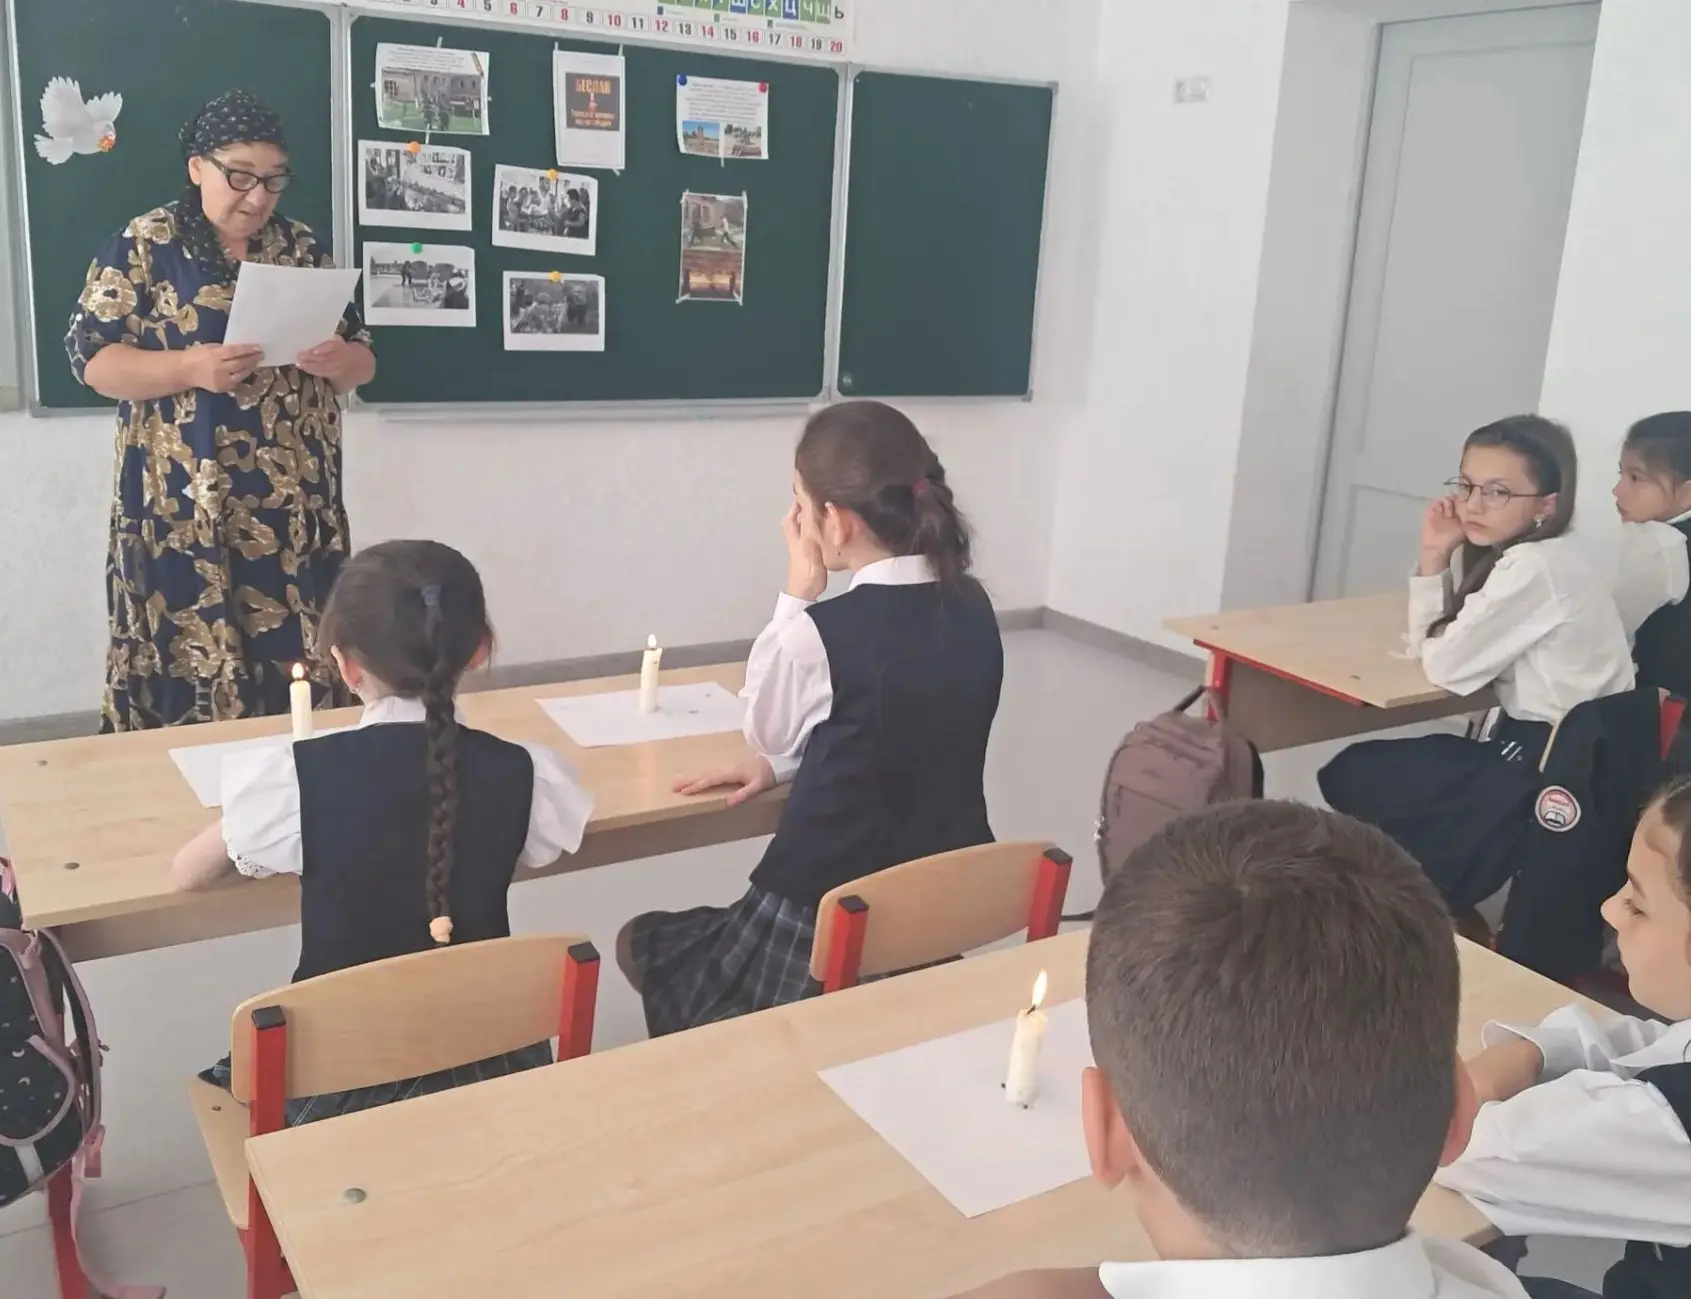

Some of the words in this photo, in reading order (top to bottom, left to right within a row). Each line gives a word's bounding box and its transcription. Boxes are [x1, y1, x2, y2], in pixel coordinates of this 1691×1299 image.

[484, 0, 491, 11] 5
[510, 2, 518, 15] 6
[535, 5, 543, 17] 7
[561, 8, 569, 20] 8
[586, 11, 594, 24] 9
[608, 14, 621, 27] 10
[631, 16, 645, 29] 11
[655, 20, 669, 33] 12
[679, 23, 692, 36] 13
[702, 25, 714, 38] 14
[724, 28, 737, 41] 15
[747, 31, 759, 43] 16
[769, 33, 781, 46] 17
[790, 36, 803, 48] 18
[811, 38, 822, 50] 19
[830, 40, 843, 53] 20
